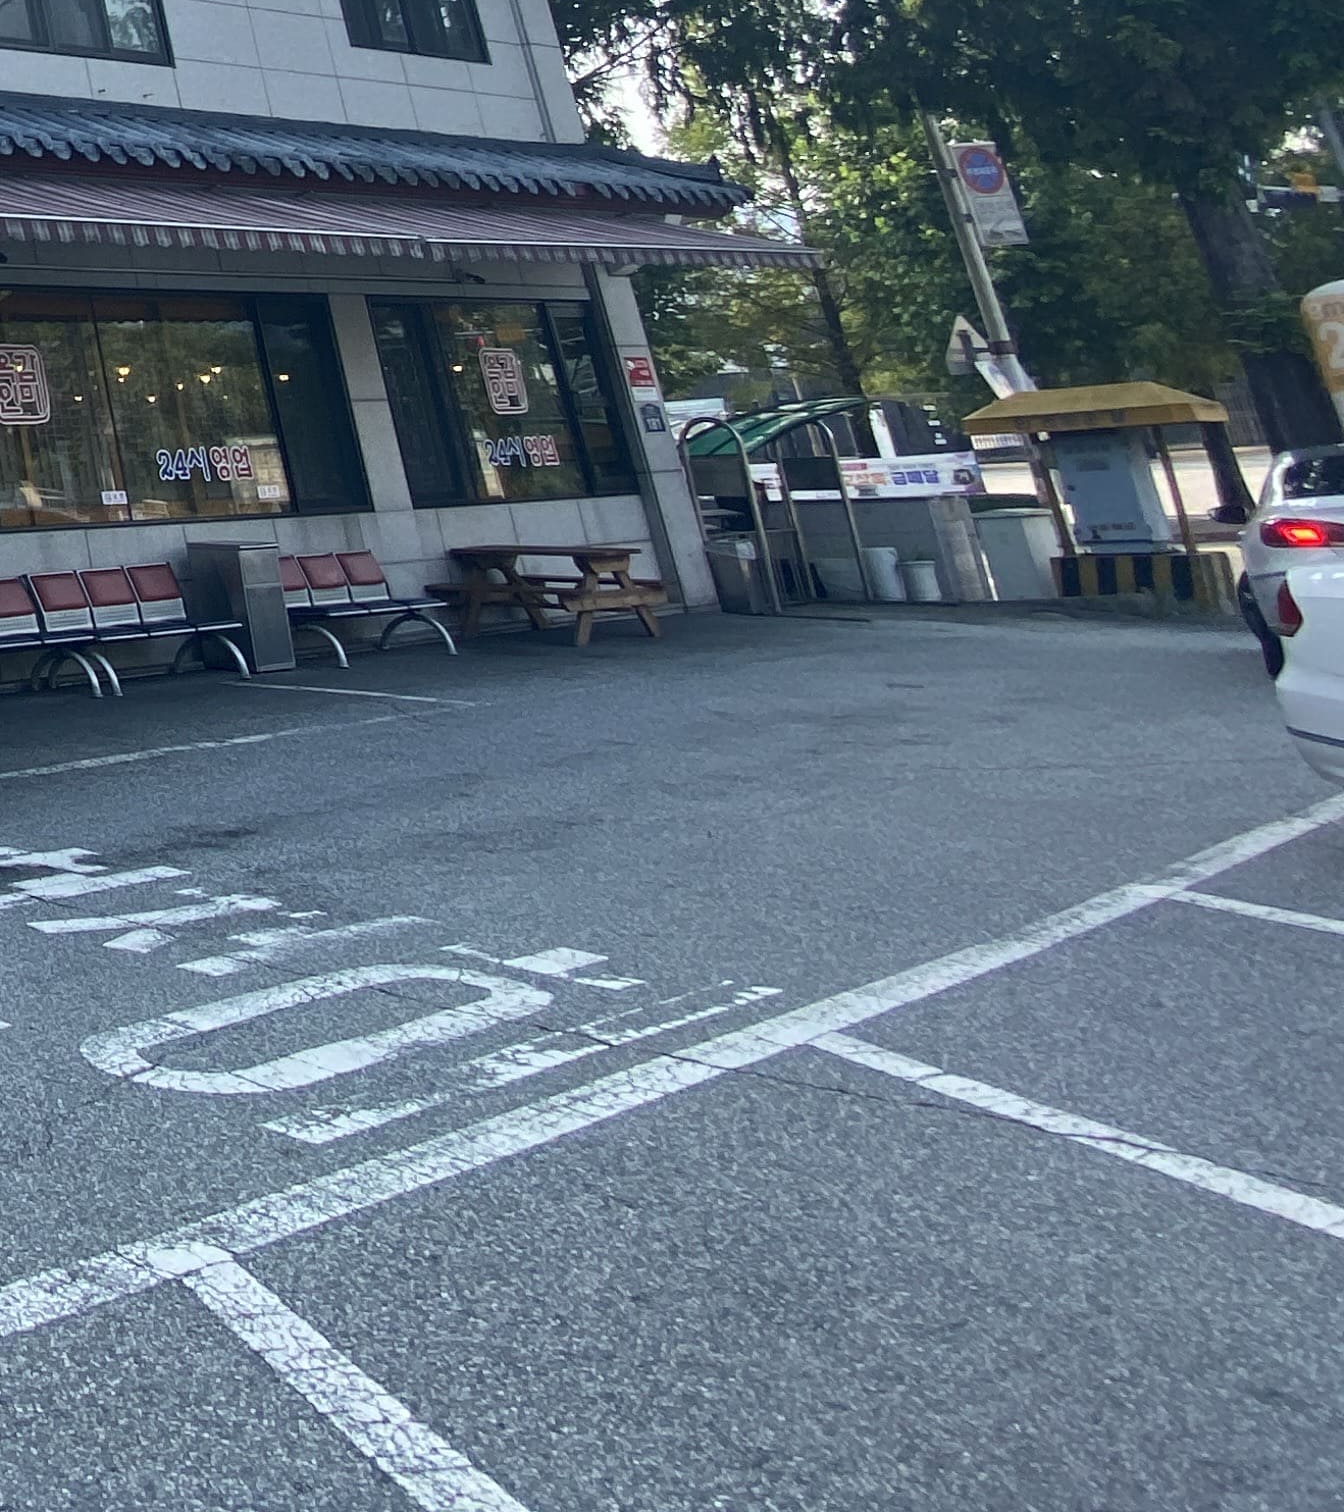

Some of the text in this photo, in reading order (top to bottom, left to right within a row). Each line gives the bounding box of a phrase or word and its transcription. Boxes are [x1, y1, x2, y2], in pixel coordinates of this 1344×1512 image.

[156, 444, 255, 482] 24시 영업
[485, 434, 561, 468] 24시 영업
